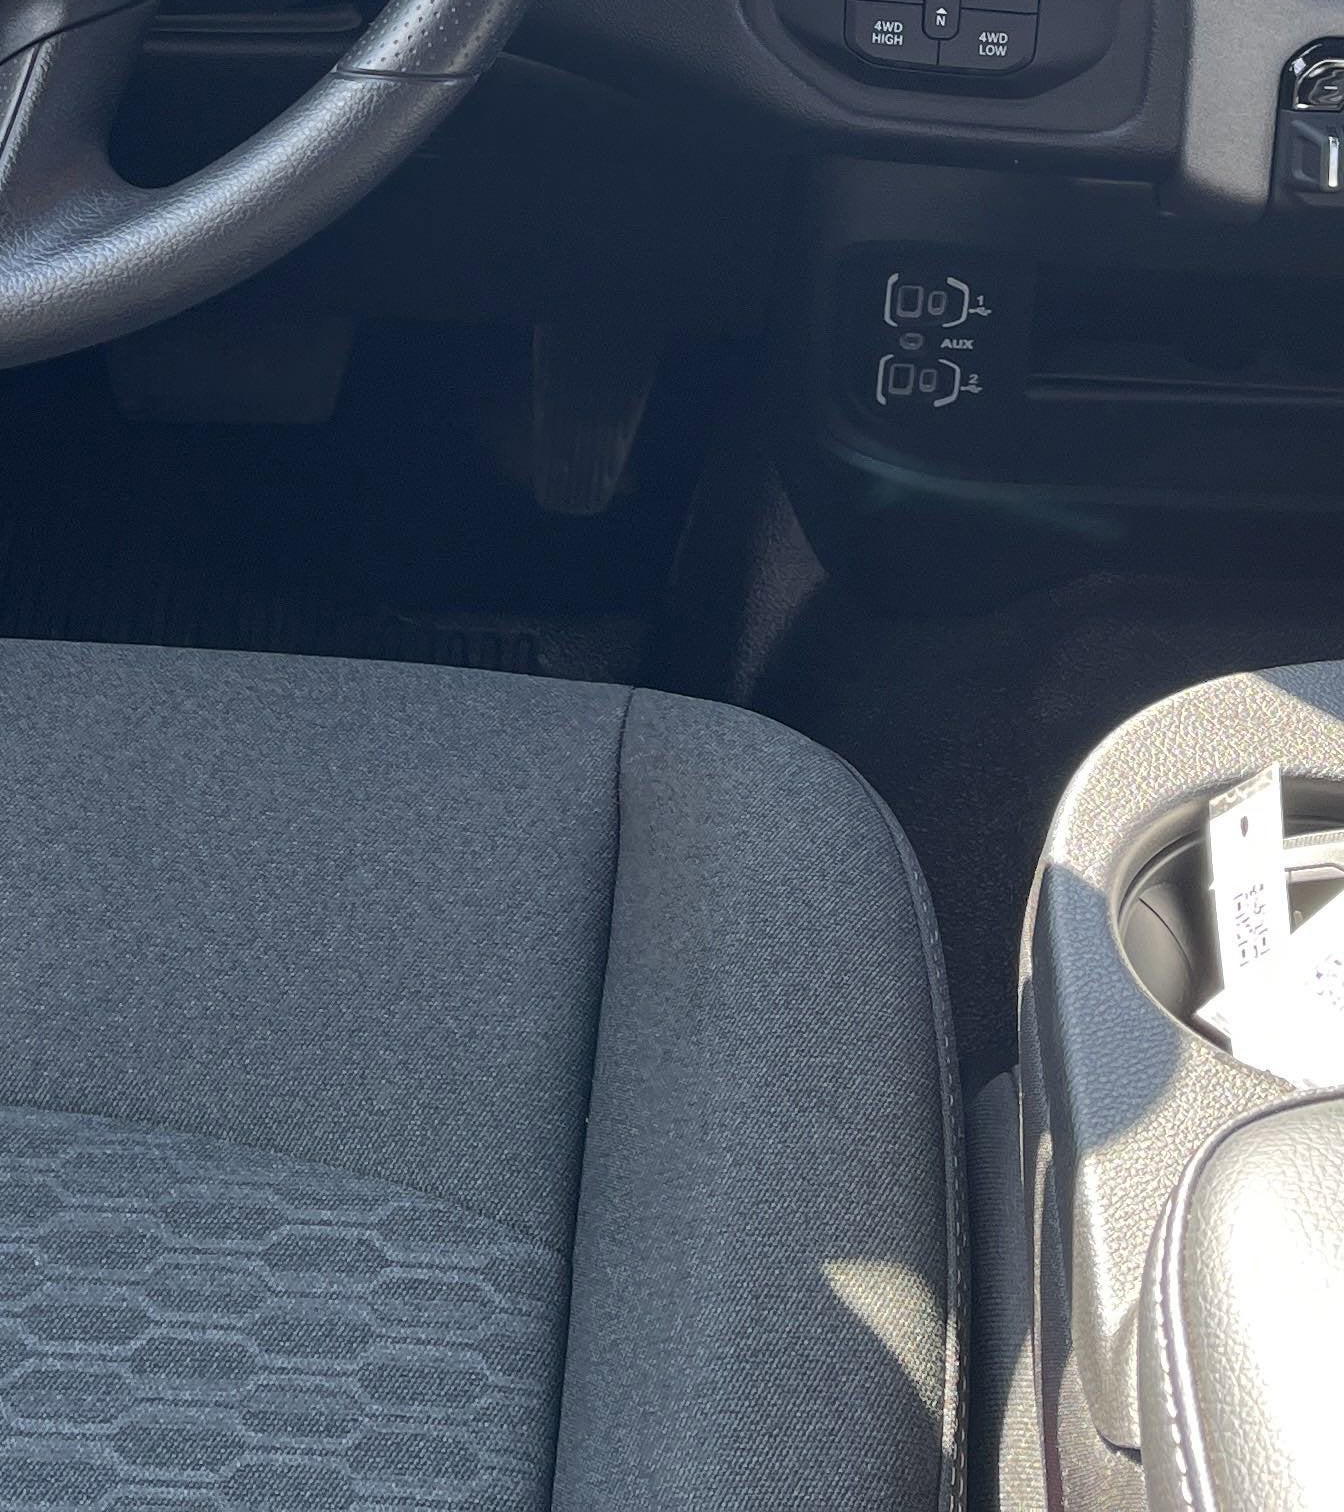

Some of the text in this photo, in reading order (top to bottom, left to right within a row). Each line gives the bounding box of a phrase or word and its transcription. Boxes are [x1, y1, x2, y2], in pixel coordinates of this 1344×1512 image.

[874, 21, 903, 34] 4WD
[936, 15, 945, 27] N
[872, 32, 904, 46] HIGH
[979, 31, 1008, 45] 4WD
[979, 44, 1008, 57] LOW
[940, 338, 974, 350] AUX
